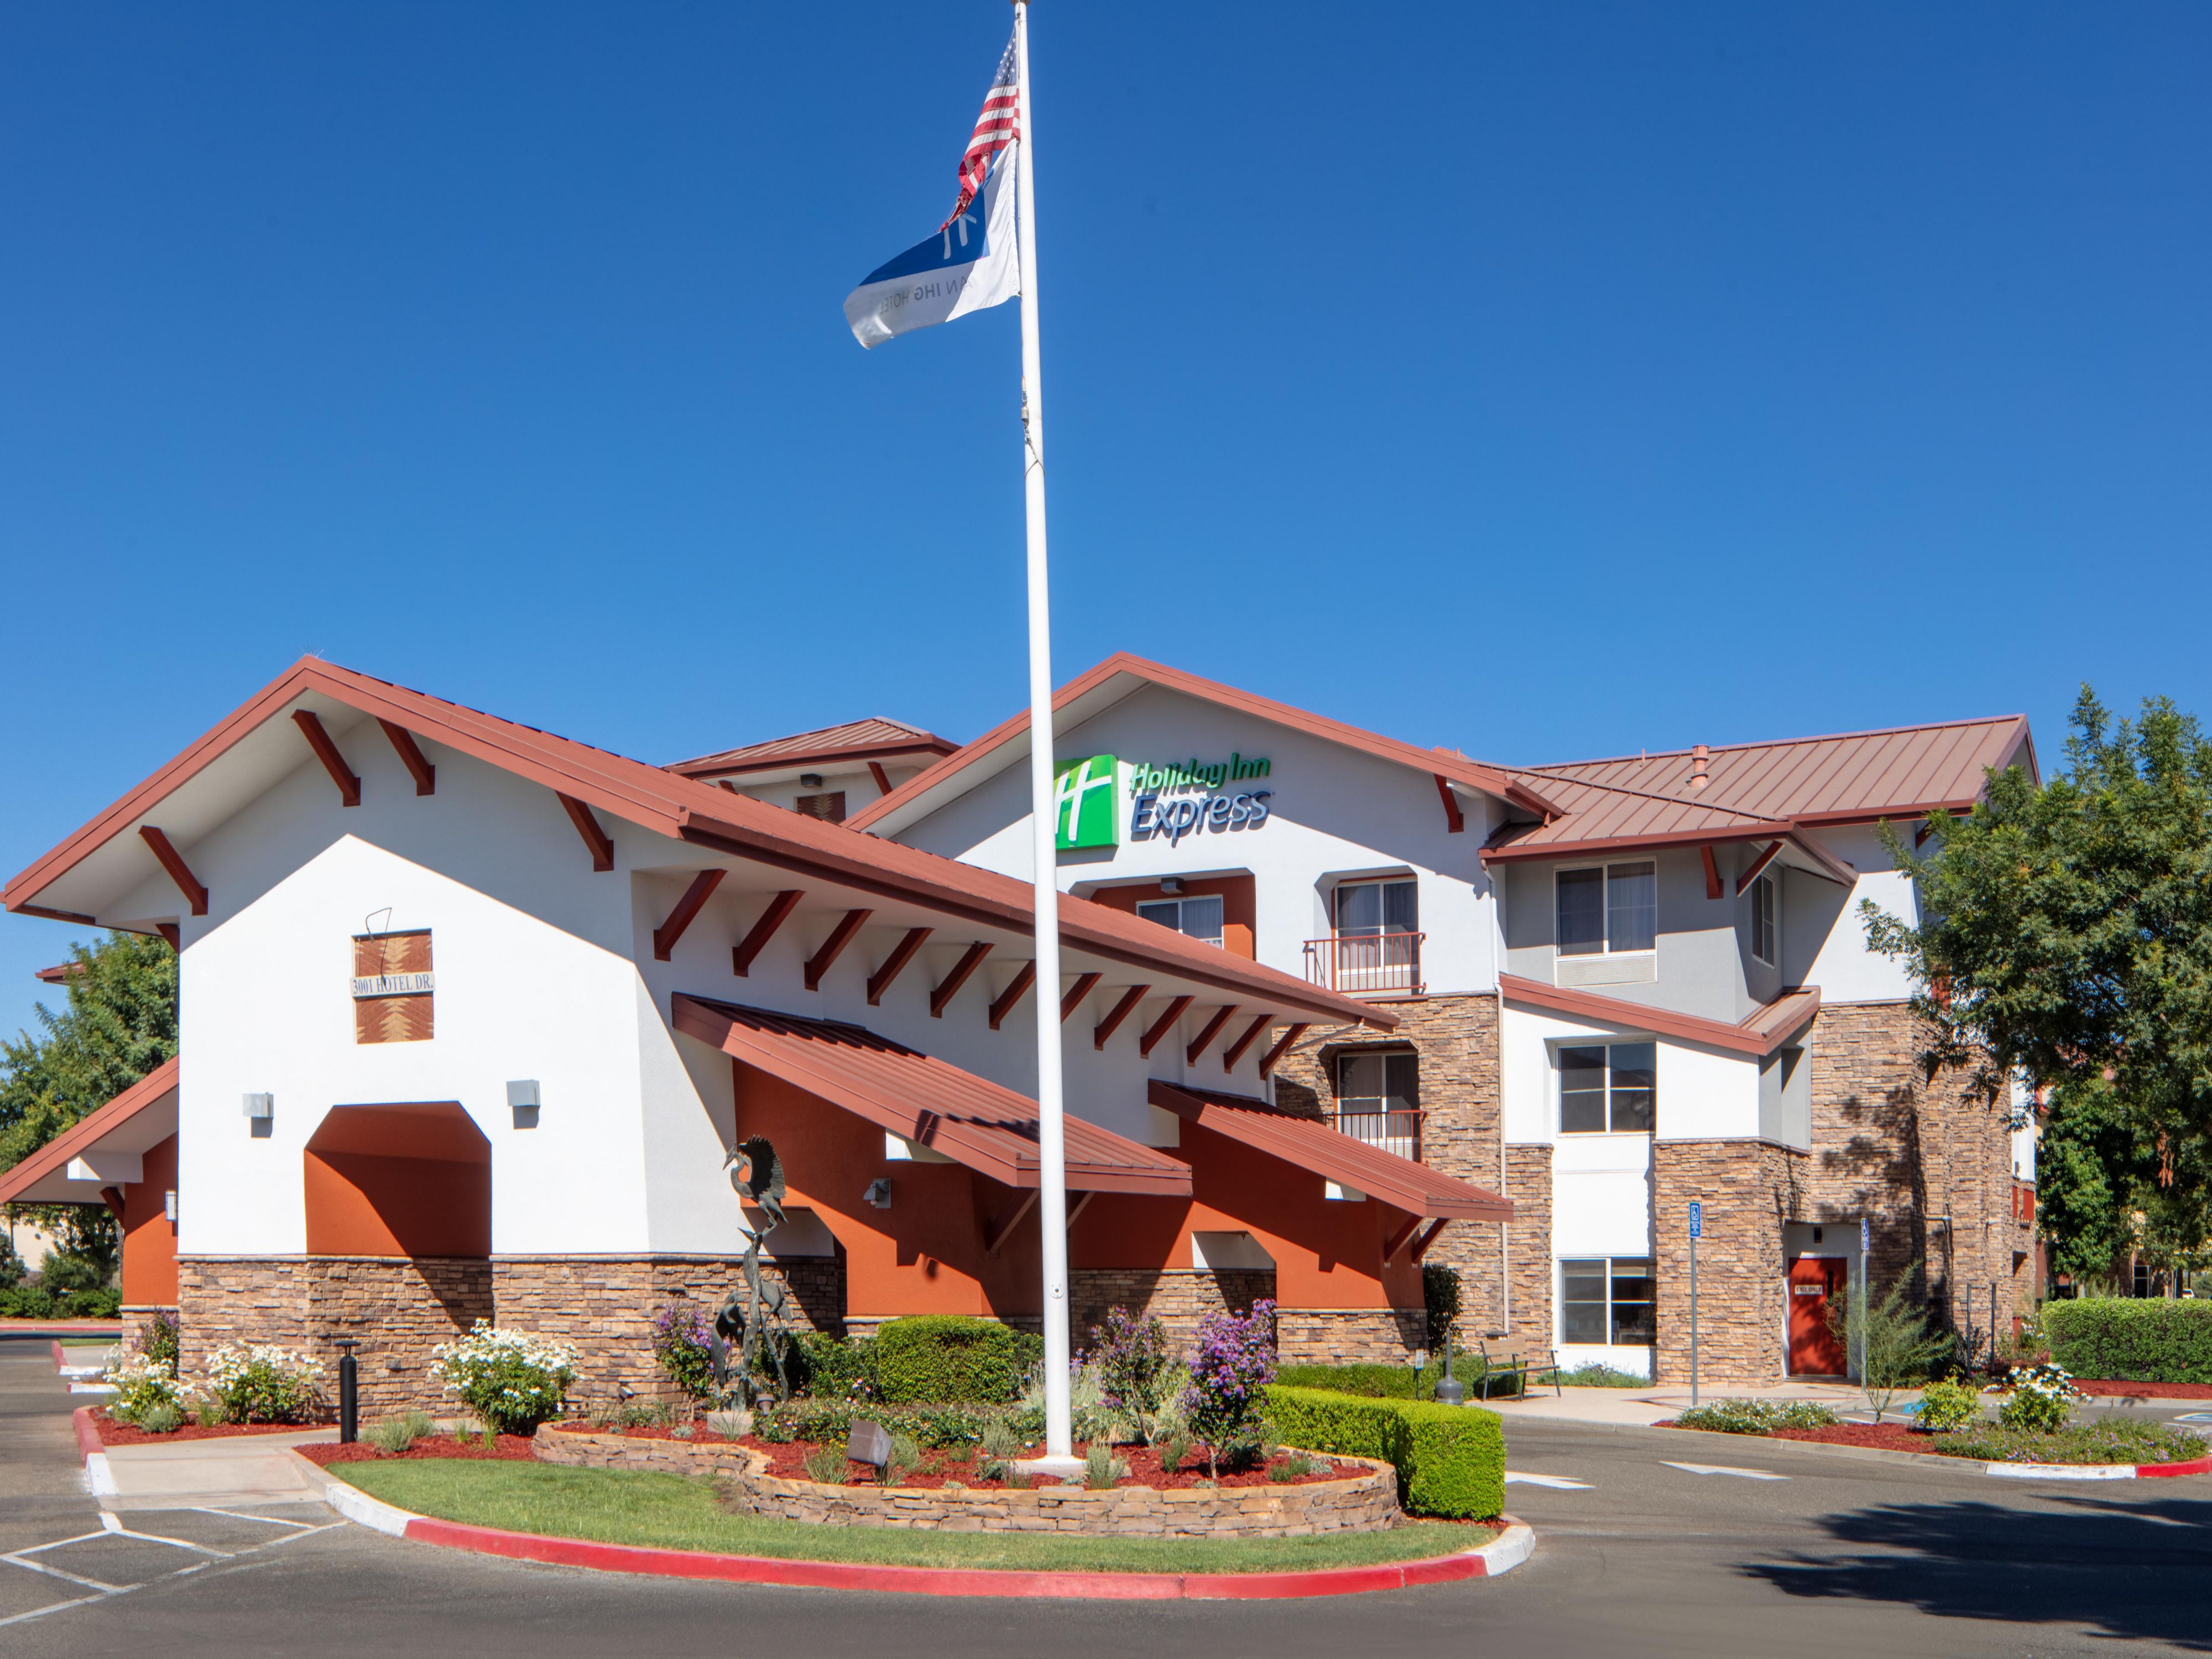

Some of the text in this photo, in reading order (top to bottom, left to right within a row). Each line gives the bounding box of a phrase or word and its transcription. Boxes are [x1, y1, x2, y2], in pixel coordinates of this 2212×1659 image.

[1130, 752, 1271, 791] Holiday Inn
[1131, 791, 1271, 839] Express
[353, 974, 434, 994] 3001 HOTEL DR.
